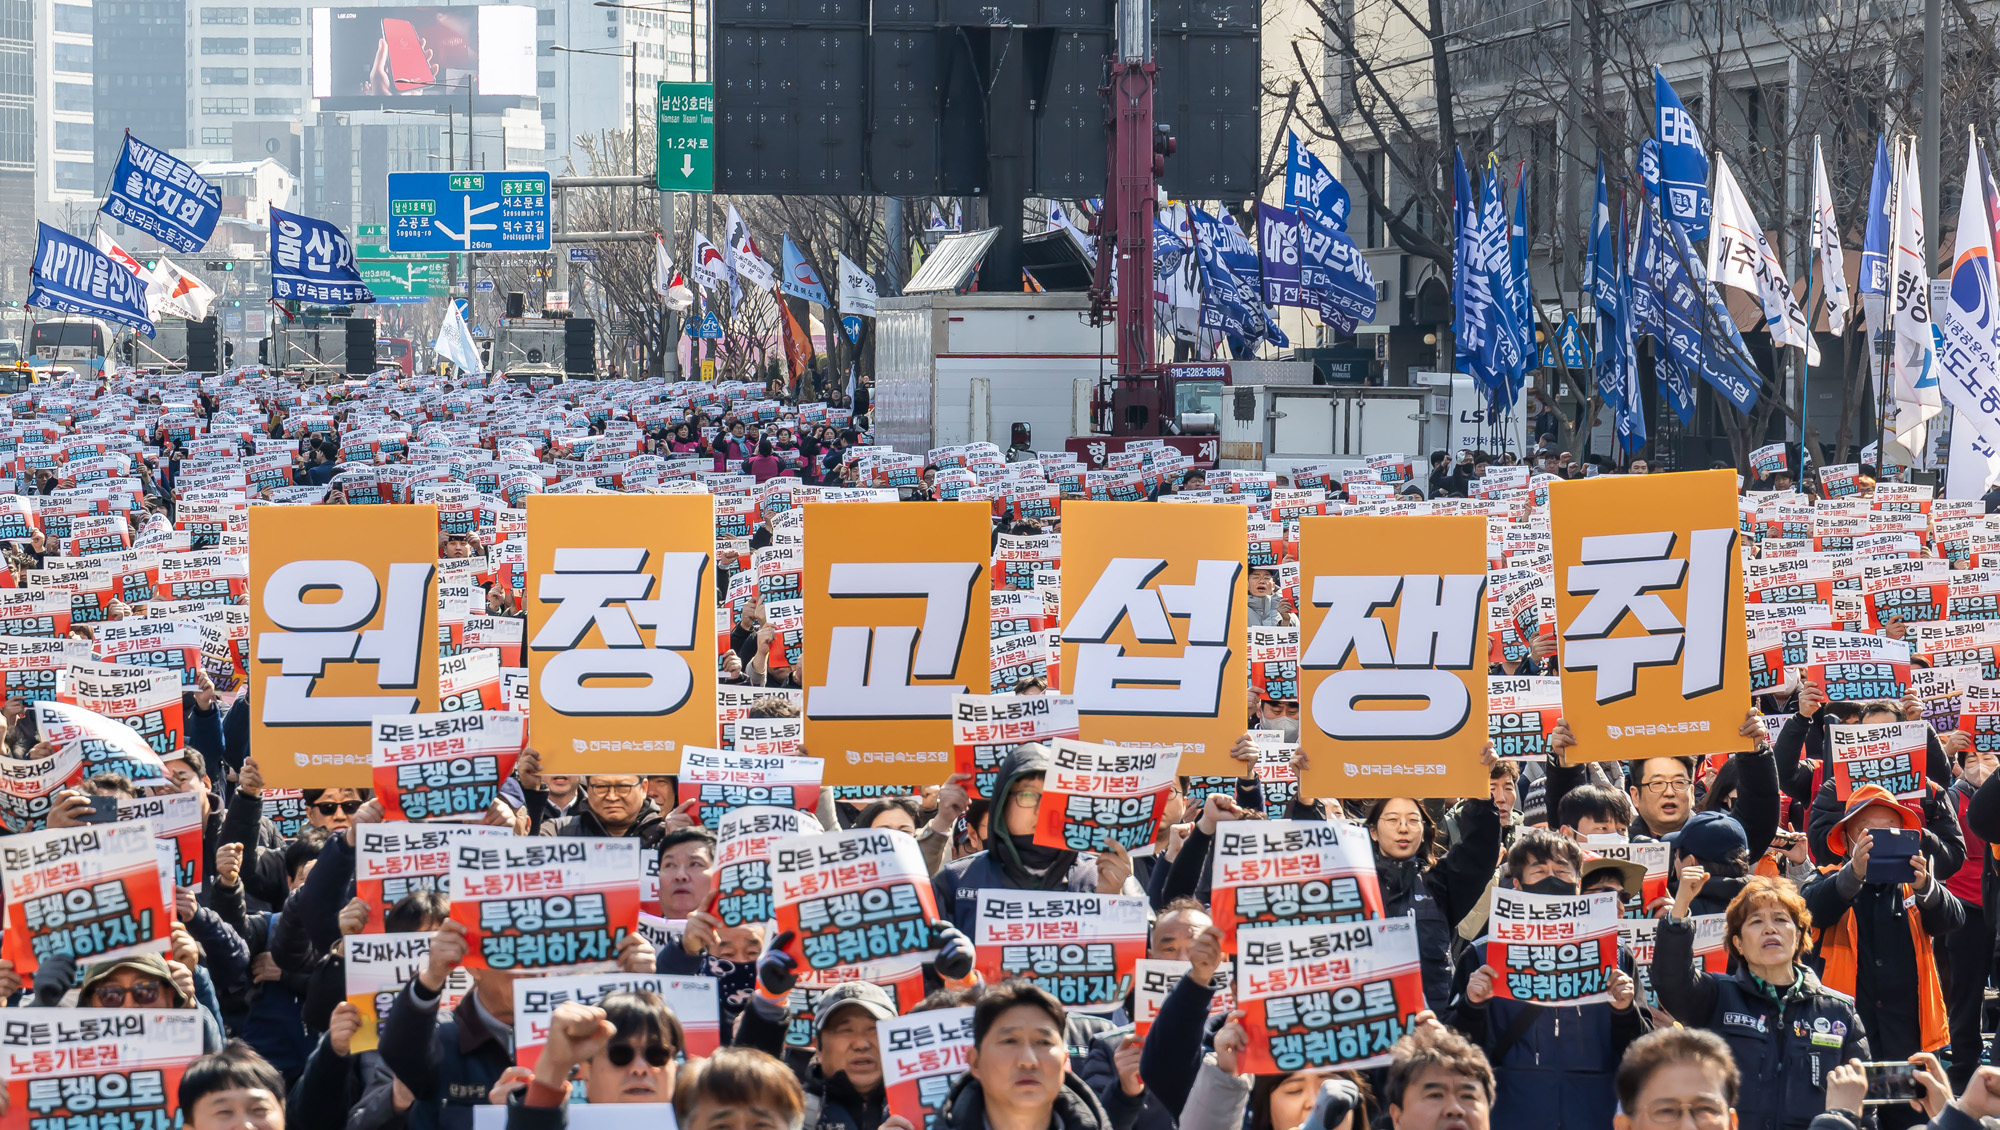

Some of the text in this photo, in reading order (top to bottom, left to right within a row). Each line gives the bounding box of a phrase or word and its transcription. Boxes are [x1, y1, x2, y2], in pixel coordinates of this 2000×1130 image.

[667, 138, 709, 149] 1.2차로
[128, 139, 220, 208] 현대글로비스
[453, 177, 482, 188] 서울역
[504, 182, 544, 193] 충정로역
[126, 171, 204, 228] 울산지회
[394, 203, 433, 214] 남산3호터널
[503, 197, 544, 208] 서소문로
[125, 208, 196, 252] 전국금속노동조합
[399, 217, 430, 228] 소공로
[503, 221, 544, 233] 덕수궁길
[397, 230, 431, 238] Sogong-ro
[278, 220, 360, 272] 울산지
[1332, 364, 1351, 372] VALET
[1460, 410, 1485, 423] LS
[1087, 440, 1217, 463] 형 제
[887, 469, 916, 478] 투쟁으로
[1274, 490, 1312, 499] 모든 노동자의
[1877, 484, 1917, 493] 모든 노동자의
[1878, 493, 1909, 501] 노동기본권
[178, 504, 217, 513] 모든 노동자의
[179, 514, 209, 522] 노동기본권
[1279, 508, 1318, 517] 투쟁으로
[1881, 503, 1920, 513] 투쟁으로
[73, 520, 88, 530] 모든
[74, 528, 108, 538] 노동기본권
[79, 535, 121, 550] 투쟁으로
[999, 538, 1049, 549] 모든 노동자의
[162, 555, 221, 570] 모든 노동자의
[1000, 551, 1039, 559] 노동기본권
[164, 569, 210, 582] 노동기본권
[1750, 559, 1808, 577] 모든 노동자의
[1864, 561, 1923, 579] 모든 노동자의
[172, 579, 229, 596] 투쟁으로
[1753, 573, 1797, 589] 노동기본권
[1867, 576, 1911, 591] 노동기본권
[1874, 587, 1932, 607] 투쟁으로
[1563, 527, 1737, 706] 취
[1746, 605, 1806, 620] 모든 노동자의
[105, 622, 174, 641] 모든 노동자의
[531, 547, 709, 716] 청
[1060, 557, 1242, 718] 섭
[1921, 622, 1985, 639] 모든 노동자의
[106, 636, 161, 654] 노동기본권
[257, 559, 435, 727] 원
[806, 562, 983, 720] 교
[1812, 636, 1883, 649] 모든 노동자의
[1924, 636, 1974, 652] 노동기본권
[1300, 574, 1486, 740] 쟁
[1815, 650, 1871, 663] 노동기본권
[1824, 663, 1895, 681] 투쟁으로
[79, 678, 151, 698] 모든 노동자의
[1826, 682, 1905, 700] 쟁취하자!
[1966, 686, 1989, 699] 모든
[958, 699, 1049, 722] 모든 노동자의
[379, 715, 484, 742] 모든 노동자의
[962, 721, 1035, 742] 노동기본권
[1623, 720, 1710, 737] 전국금속노동조합
[1834, 724, 1902, 745] 모든 노동자의
[384, 737, 465, 763] 노동기본권
[589, 740, 675, 752] 전국금속노동조합
[1838, 742, 1890, 760] 노동기본권
[687, 753, 784, 770] 모든 노동자의
[862, 750, 948, 763] 전국금속노동조합
[1055, 748, 1156, 773] 모든 노동자의
[1847, 753, 1911, 778] 투쟁으로
[398, 755, 498, 790] 투쟁으로
[690, 771, 764, 784] 노동기본권
[1361, 763, 1446, 775] 전국금속노동조합
[1056, 773, 1139, 793] 노동기본권
[700, 784, 794, 805] 투쟁으로
[1066, 794, 1156, 825] 투쟁으로
[720, 815, 798, 843] 모든 노동자의
[4, 830, 100, 871] 모든 노동자의
[363, 832, 400, 853] 모든
[1222, 827, 1339, 856] 모든 노동자의
[457, 842, 587, 870] 모든 노동자의
[778, 834, 895, 873] 모든 노동자의
[1223, 854, 1321, 883] 노동기본권
[11, 862, 81, 898] 노동기본권
[463, 868, 563, 897] 노동기본권
[783, 861, 878, 900] 노동기본권
[24, 879, 130, 931] 투쟁으로
[1235, 876, 1365, 918] 투쟁으로
[479, 892, 608, 935] 투쟁으로
[799, 883, 922, 932] 투쟁으로
[984, 898, 1101, 919] 모든 노동자의
[1495, 897, 1591, 920] 모든 노동자의
[988, 921, 1079, 941] 노동기본권
[1497, 922, 1574, 941] 노동기본권
[482, 927, 628, 970] 쟁취하자!
[1244, 926, 1373, 965] 모든 노동자의
[1506, 939, 1600, 972] 투쟁으로
[1001, 944, 1115, 974] 투쟁으로
[1249, 958, 1352, 995] 노동기본권
[1507, 966, 1612, 1001] 쟁취하자!
[1265, 979, 1397, 1031] 투쟁으로
[3, 1014, 145, 1046] 모든 노동자의
[888, 1028, 934, 1052] 모든
[10, 1044, 119, 1075] 노동기본권
[28, 1069, 166, 1113] 투쟁으로
